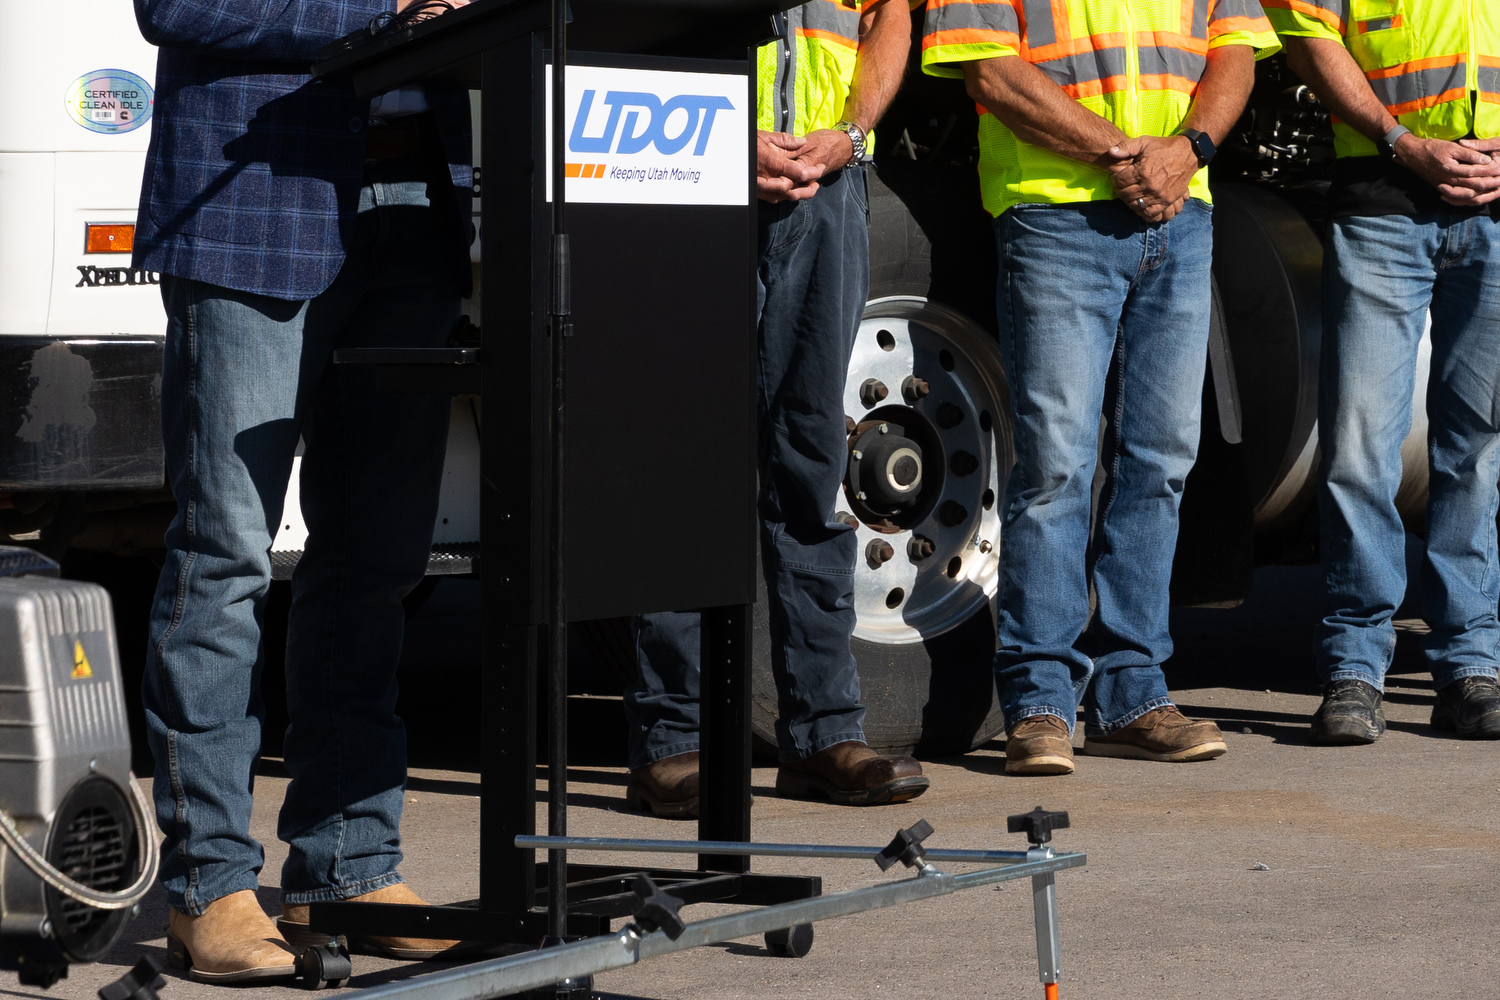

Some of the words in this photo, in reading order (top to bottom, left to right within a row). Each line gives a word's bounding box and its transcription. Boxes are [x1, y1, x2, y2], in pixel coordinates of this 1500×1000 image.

[84, 90, 138, 99] CERTIFIED
[79, 101, 116, 110] CLEAN
[120, 101, 144, 110] IDLE
[568, 89, 736, 156] UDOT
[610, 166, 645, 183] Keeping
[647, 166, 668, 181] Utah
[669, 167, 701, 184] Moving
